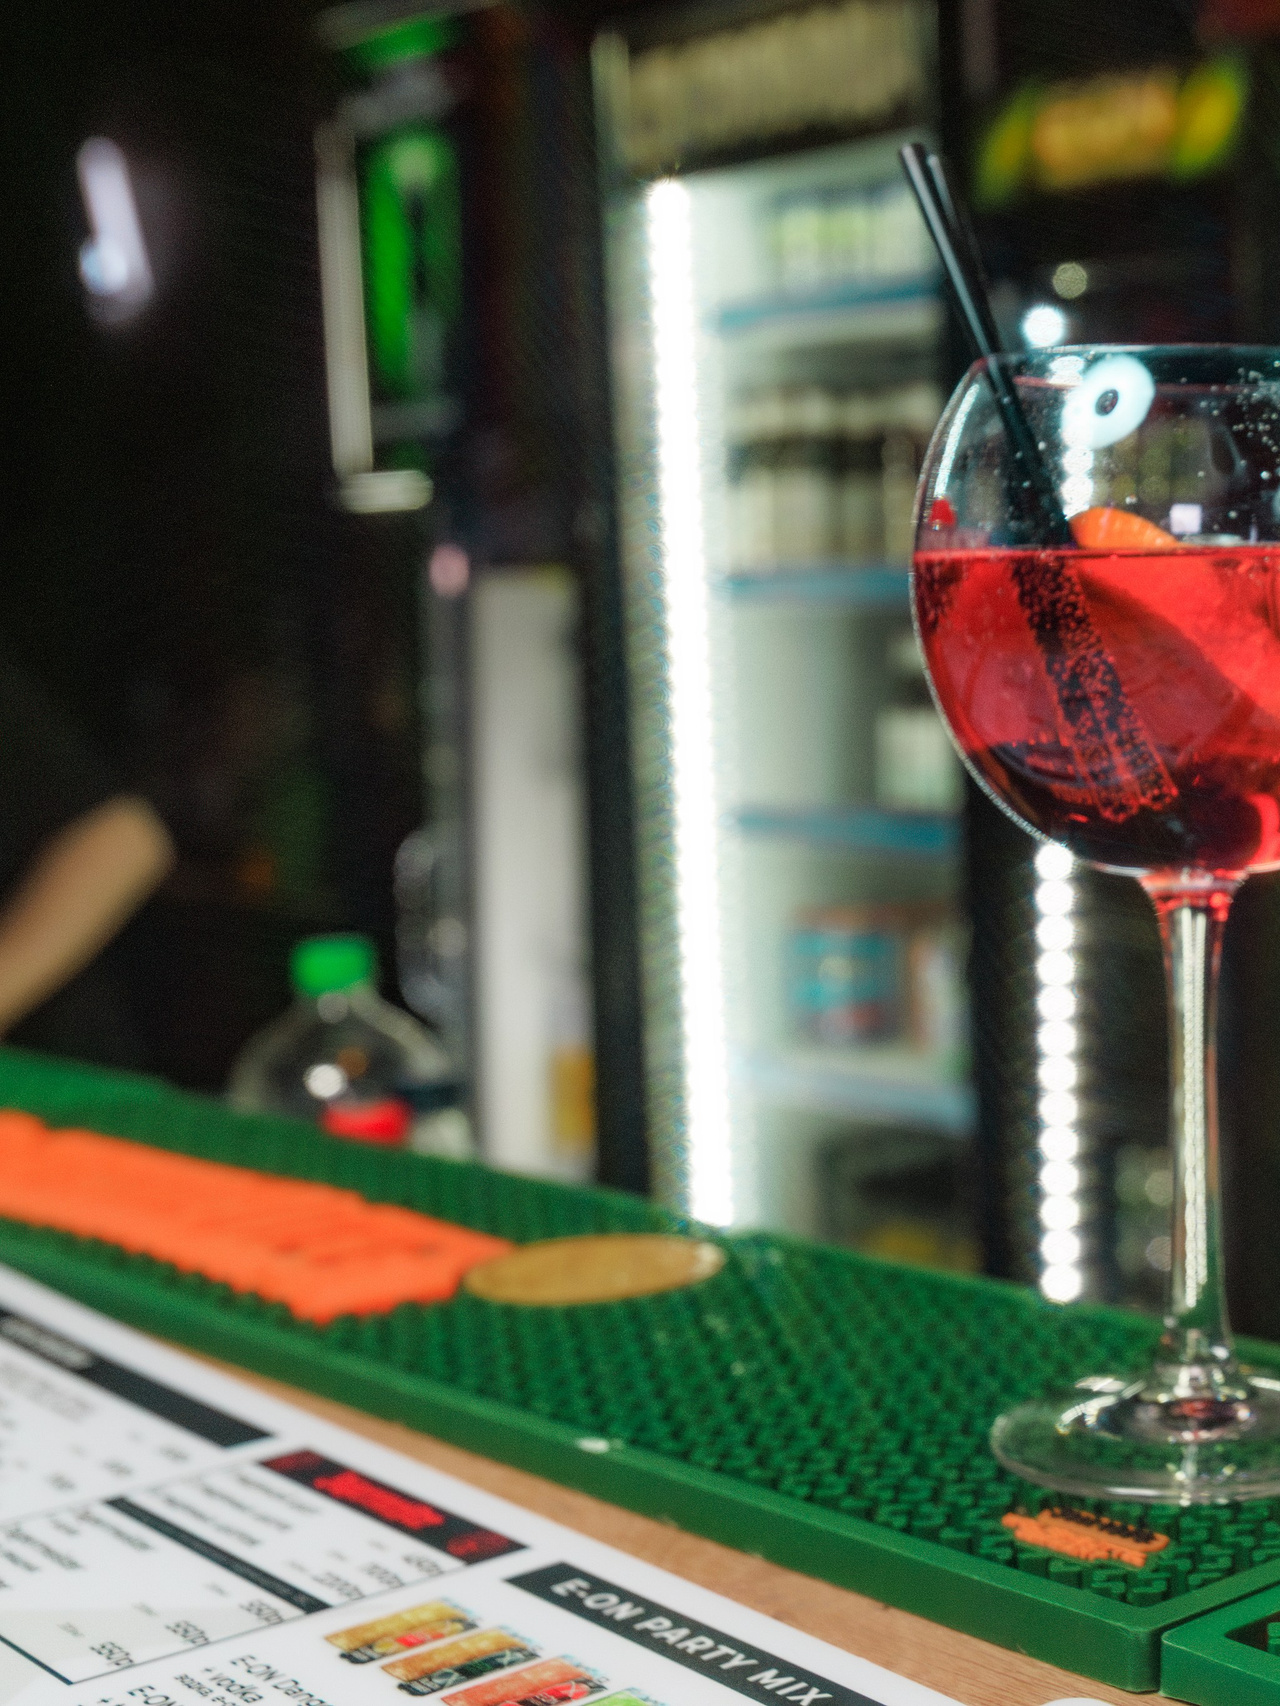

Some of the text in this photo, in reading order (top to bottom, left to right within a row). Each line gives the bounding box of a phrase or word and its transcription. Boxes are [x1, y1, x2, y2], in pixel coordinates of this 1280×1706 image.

[550, 1577, 833, 1706] E-ON PARTY MIX
[209, 1673, 263, 1704] vodka
[230, 1655, 334, 1706] E-ON Dang
